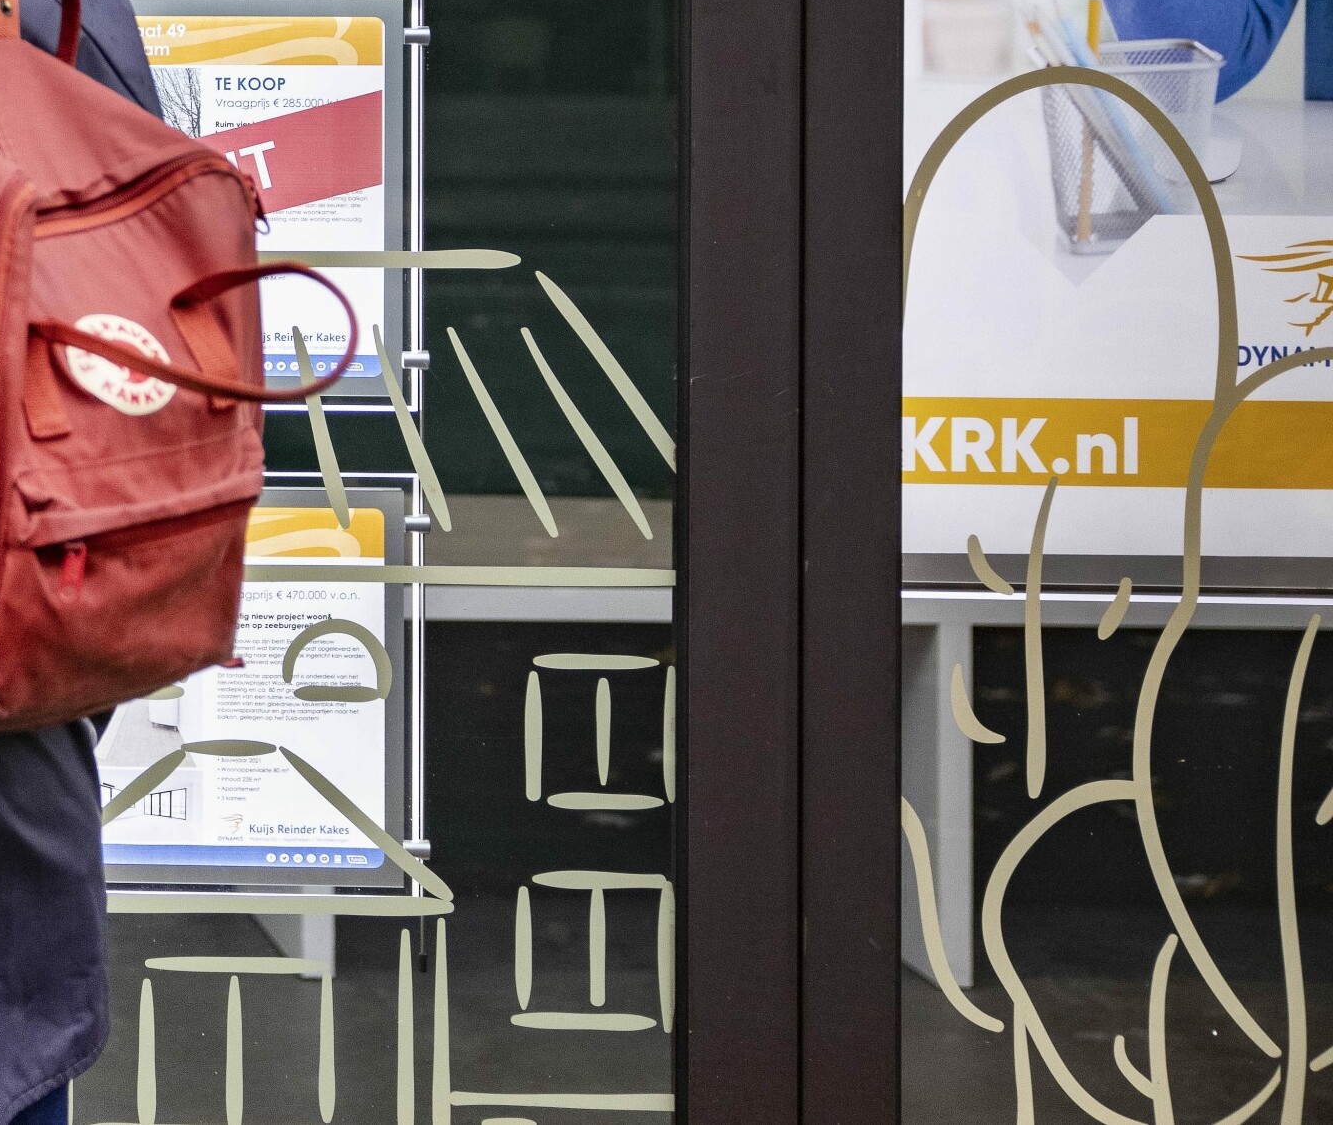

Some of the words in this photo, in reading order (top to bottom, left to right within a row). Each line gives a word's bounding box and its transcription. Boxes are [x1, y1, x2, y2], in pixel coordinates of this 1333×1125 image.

[167, 24, 186, 38] 49
[215, 78, 231, 90] TE
[238, 77, 285, 90] KOOP
[216, 98, 270, 110] Vraagprijs
[273, 99, 279, 107] €
[283, 99, 326, 108] 285.000
[317, 333, 346, 342] Kakes
[902, 417, 1139, 475] KRK.nl
[276, 590, 282, 599] €
[286, 590, 326, 599] 470.000
[250, 824, 274, 835] Kuijs
[278, 825, 316, 834] Reinder
[320, 825, 349, 834] Kakes
